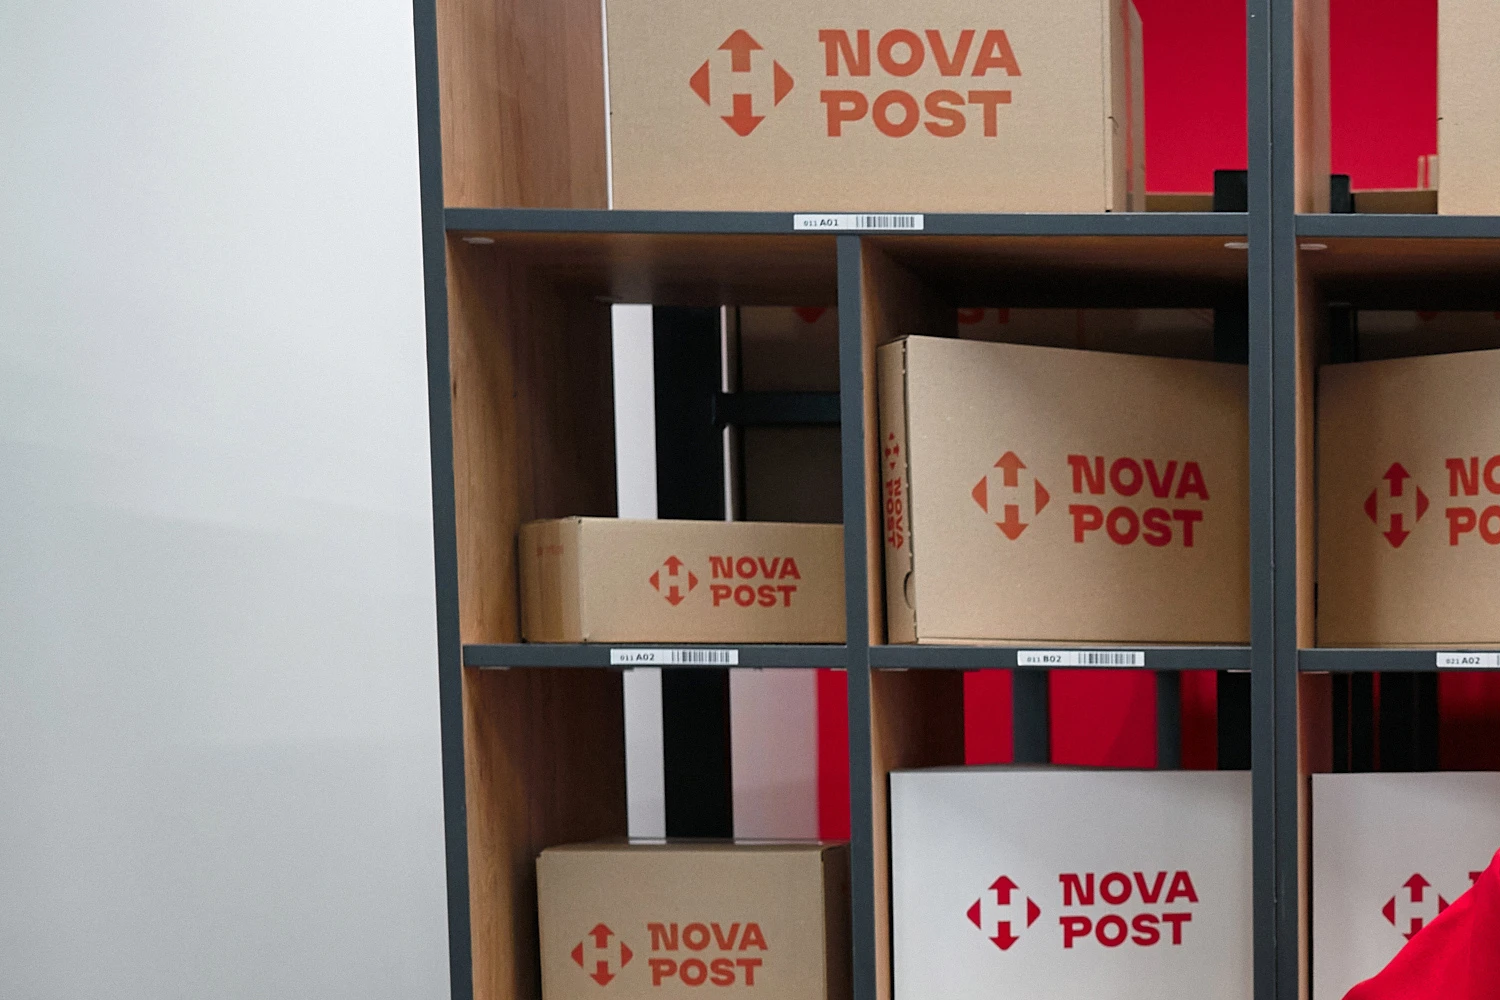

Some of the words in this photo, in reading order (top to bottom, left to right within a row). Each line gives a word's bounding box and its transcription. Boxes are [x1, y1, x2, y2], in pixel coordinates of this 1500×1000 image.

[819, 29, 1022, 77] NOVA
[820, 90, 1012, 138] POST
[1068, 455, 1209, 500] NOVA
[894, 477, 903, 549] NOVA
[1070, 504, 1203, 547] POST
[709, 556, 800, 580] NOVA
[710, 584, 797, 608] POST
[636, 653, 655, 661] A02
[1043, 655, 1061, 663] B02
[1060, 872, 1198, 906] NOVA
[648, 923, 768, 952] NOVA
[1060, 912, 1192, 948] POST
[649, 957, 763, 987] POST
